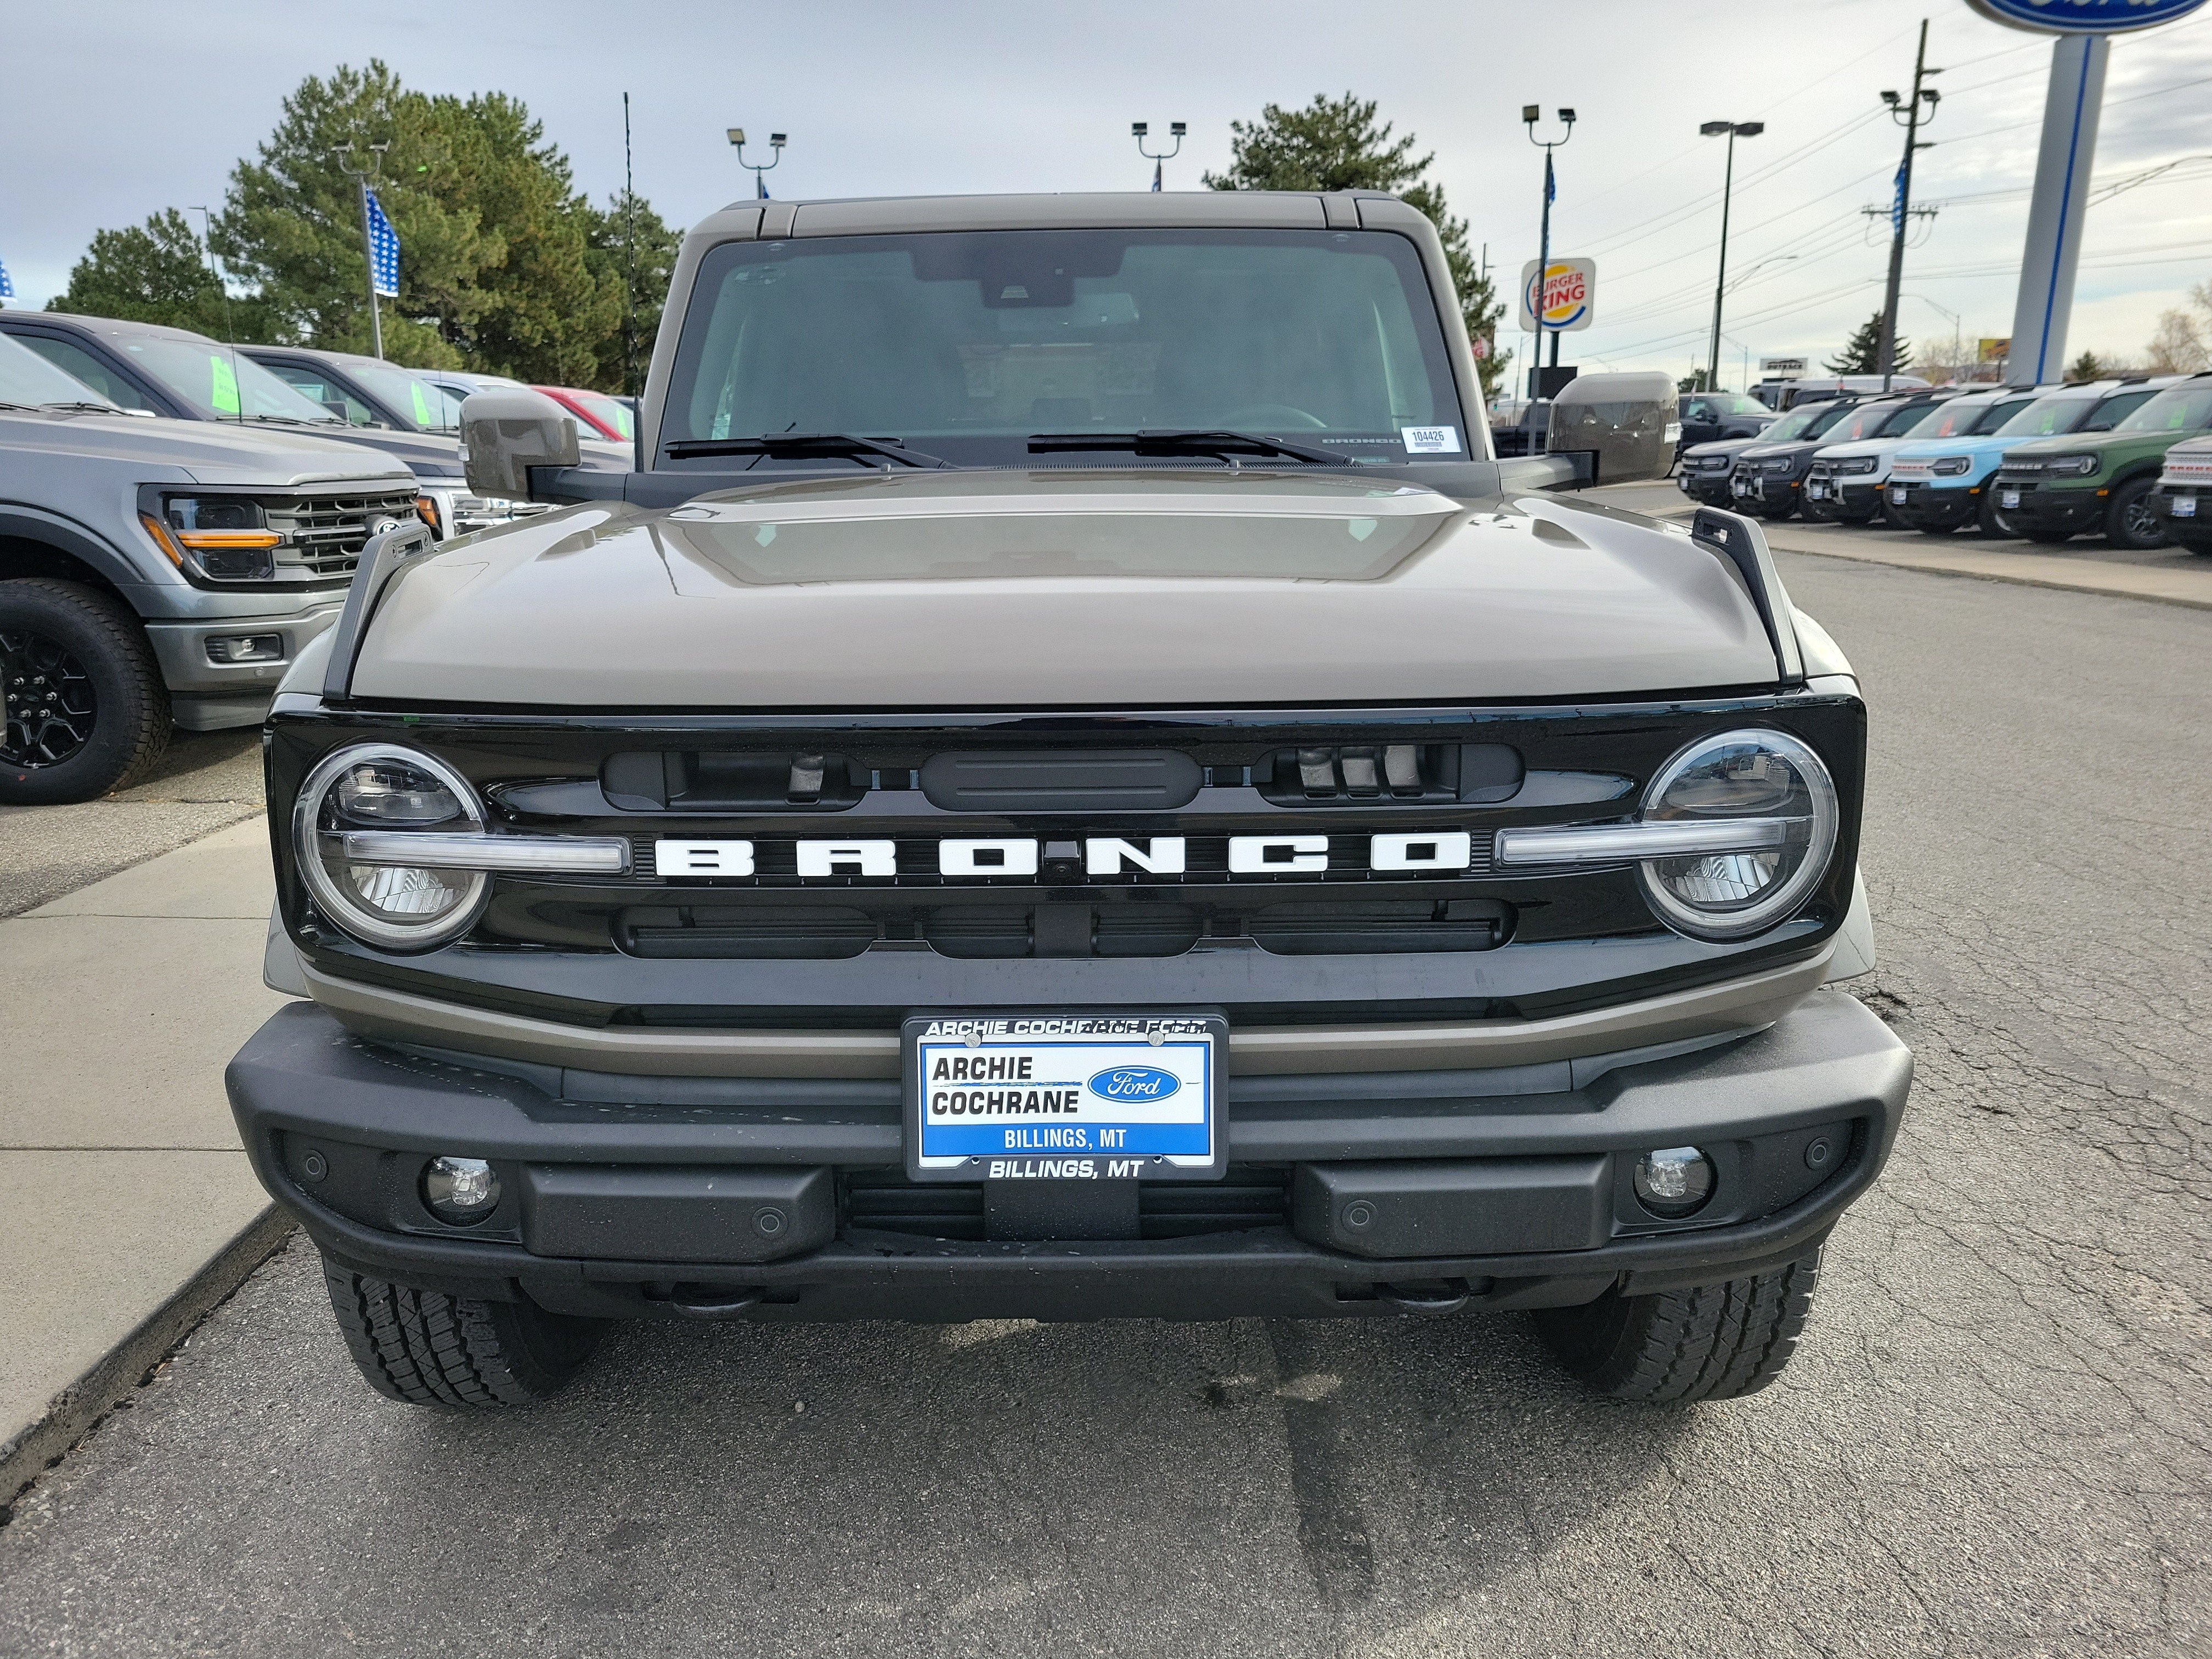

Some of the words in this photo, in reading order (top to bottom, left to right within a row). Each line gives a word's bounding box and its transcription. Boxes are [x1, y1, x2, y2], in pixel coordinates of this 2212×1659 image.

[1532, 285, 1584, 317] KING
[1412, 431, 1444, 441] 104426
[655, 833, 1471, 877] BRONCO
[924, 1020, 1008, 1036] ARCHIE
[932, 1056, 1033, 1081] ARCHIE
[1107, 1071, 1161, 1095] Ford
[932, 1090, 1079, 1115] COCHRANE
[1005, 1128, 1094, 1151] BILLINGS,
[1099, 1128, 1127, 1148] MT
[988, 1159, 1099, 1180] BILLINGS,
[1107, 1159, 1146, 1178] MT
